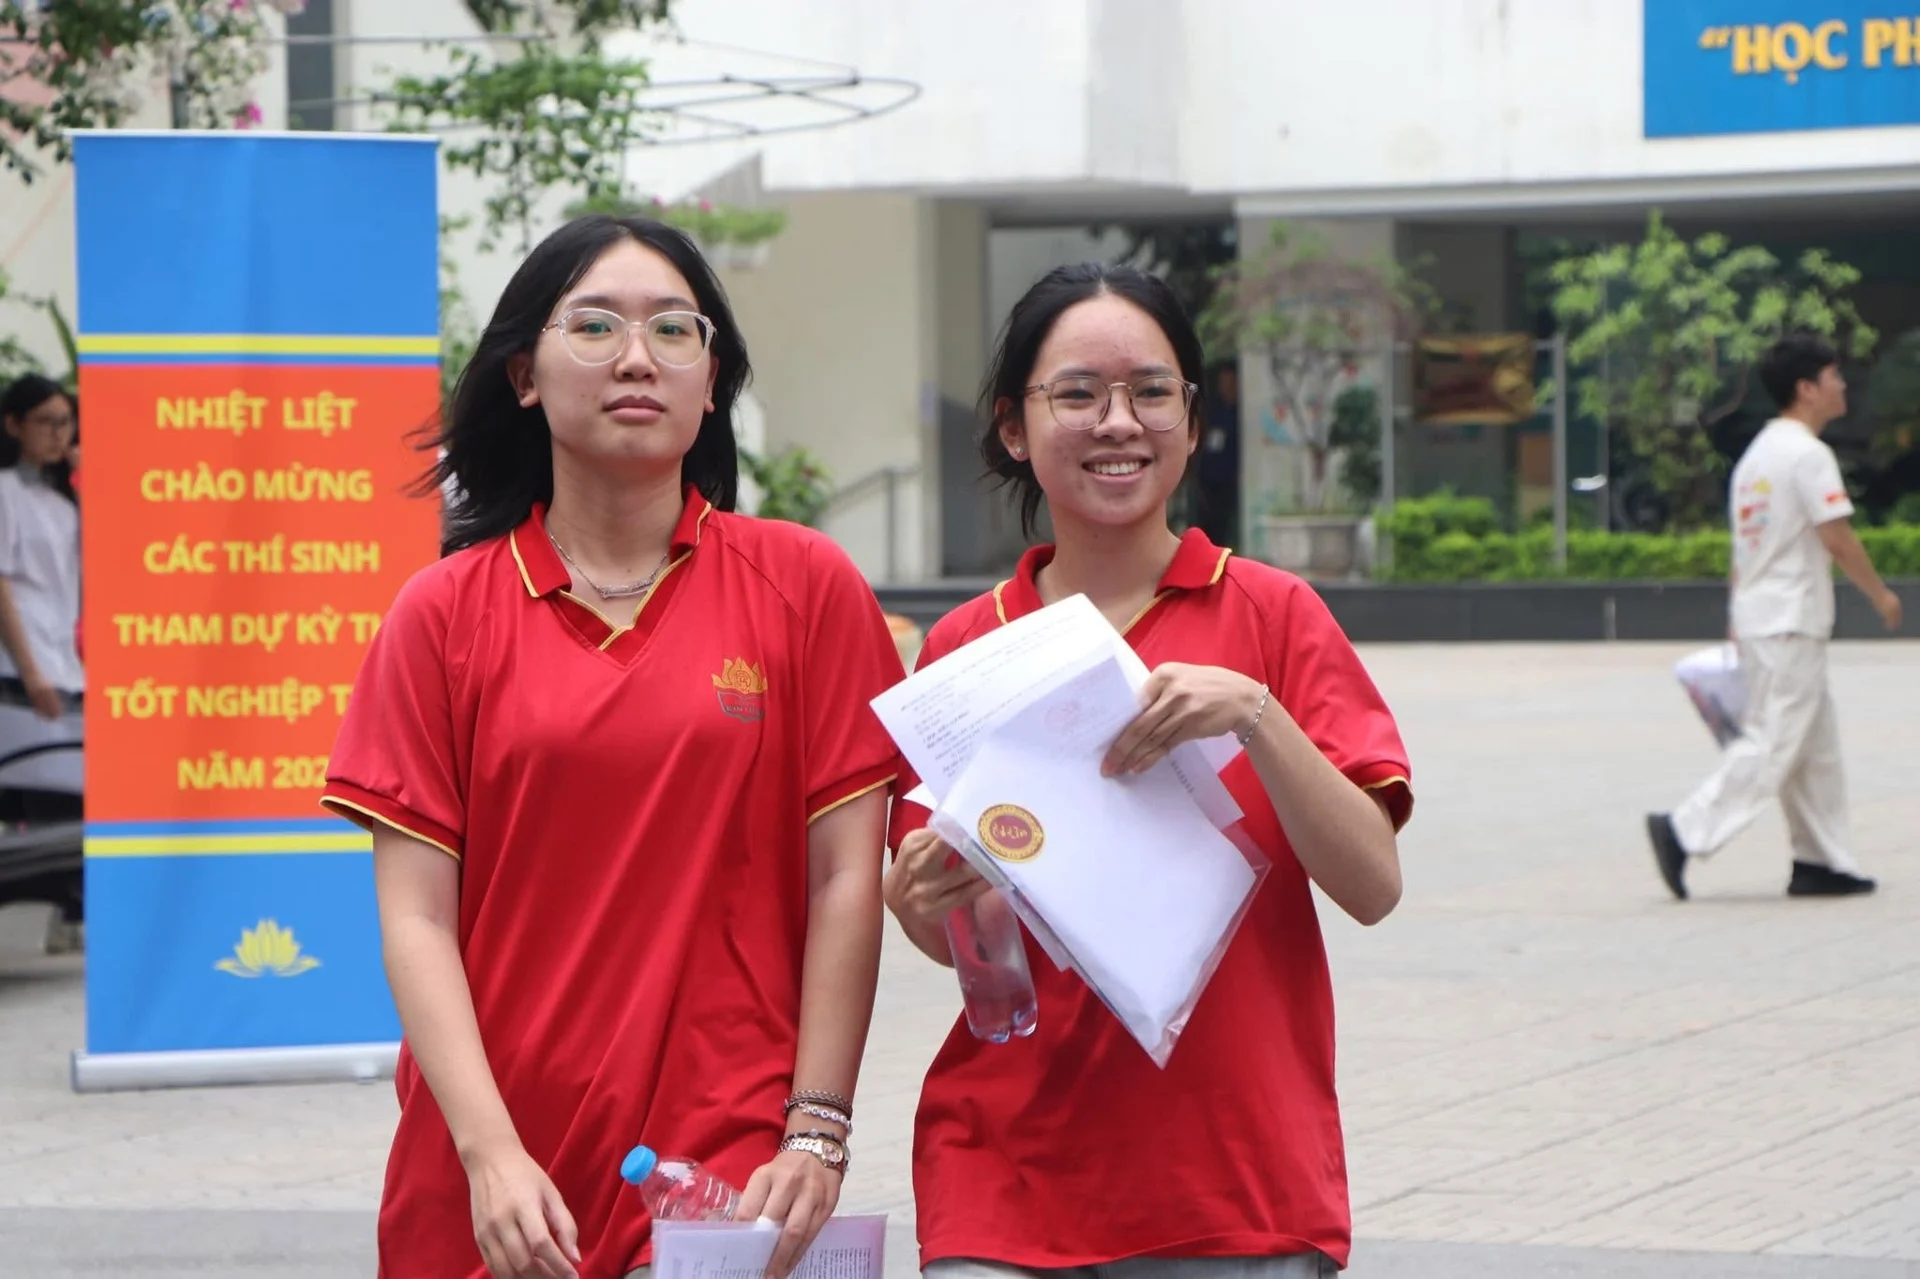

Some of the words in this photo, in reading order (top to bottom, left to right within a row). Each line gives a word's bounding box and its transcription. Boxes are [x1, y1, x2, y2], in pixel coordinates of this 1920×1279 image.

[156, 389, 267, 436] NHIỆT
[283, 390, 357, 437] LIỆT
[141, 462, 246, 502] CHÀO
[254, 462, 373, 502] MỪNG
[143, 534, 216, 574] CÁC
[223, 534, 284, 573] THÍ
[290, 541, 380, 574] SINH
[112, 612, 223, 647] THAM
[231, 612, 290, 652] DỰ
[296, 604, 343, 645] KỲ
[105, 677, 179, 719] TỐT
[186, 677, 324, 725] NGHIỆP
[177, 751, 266, 790] NĂM
[272, 756, 328, 790] 202
